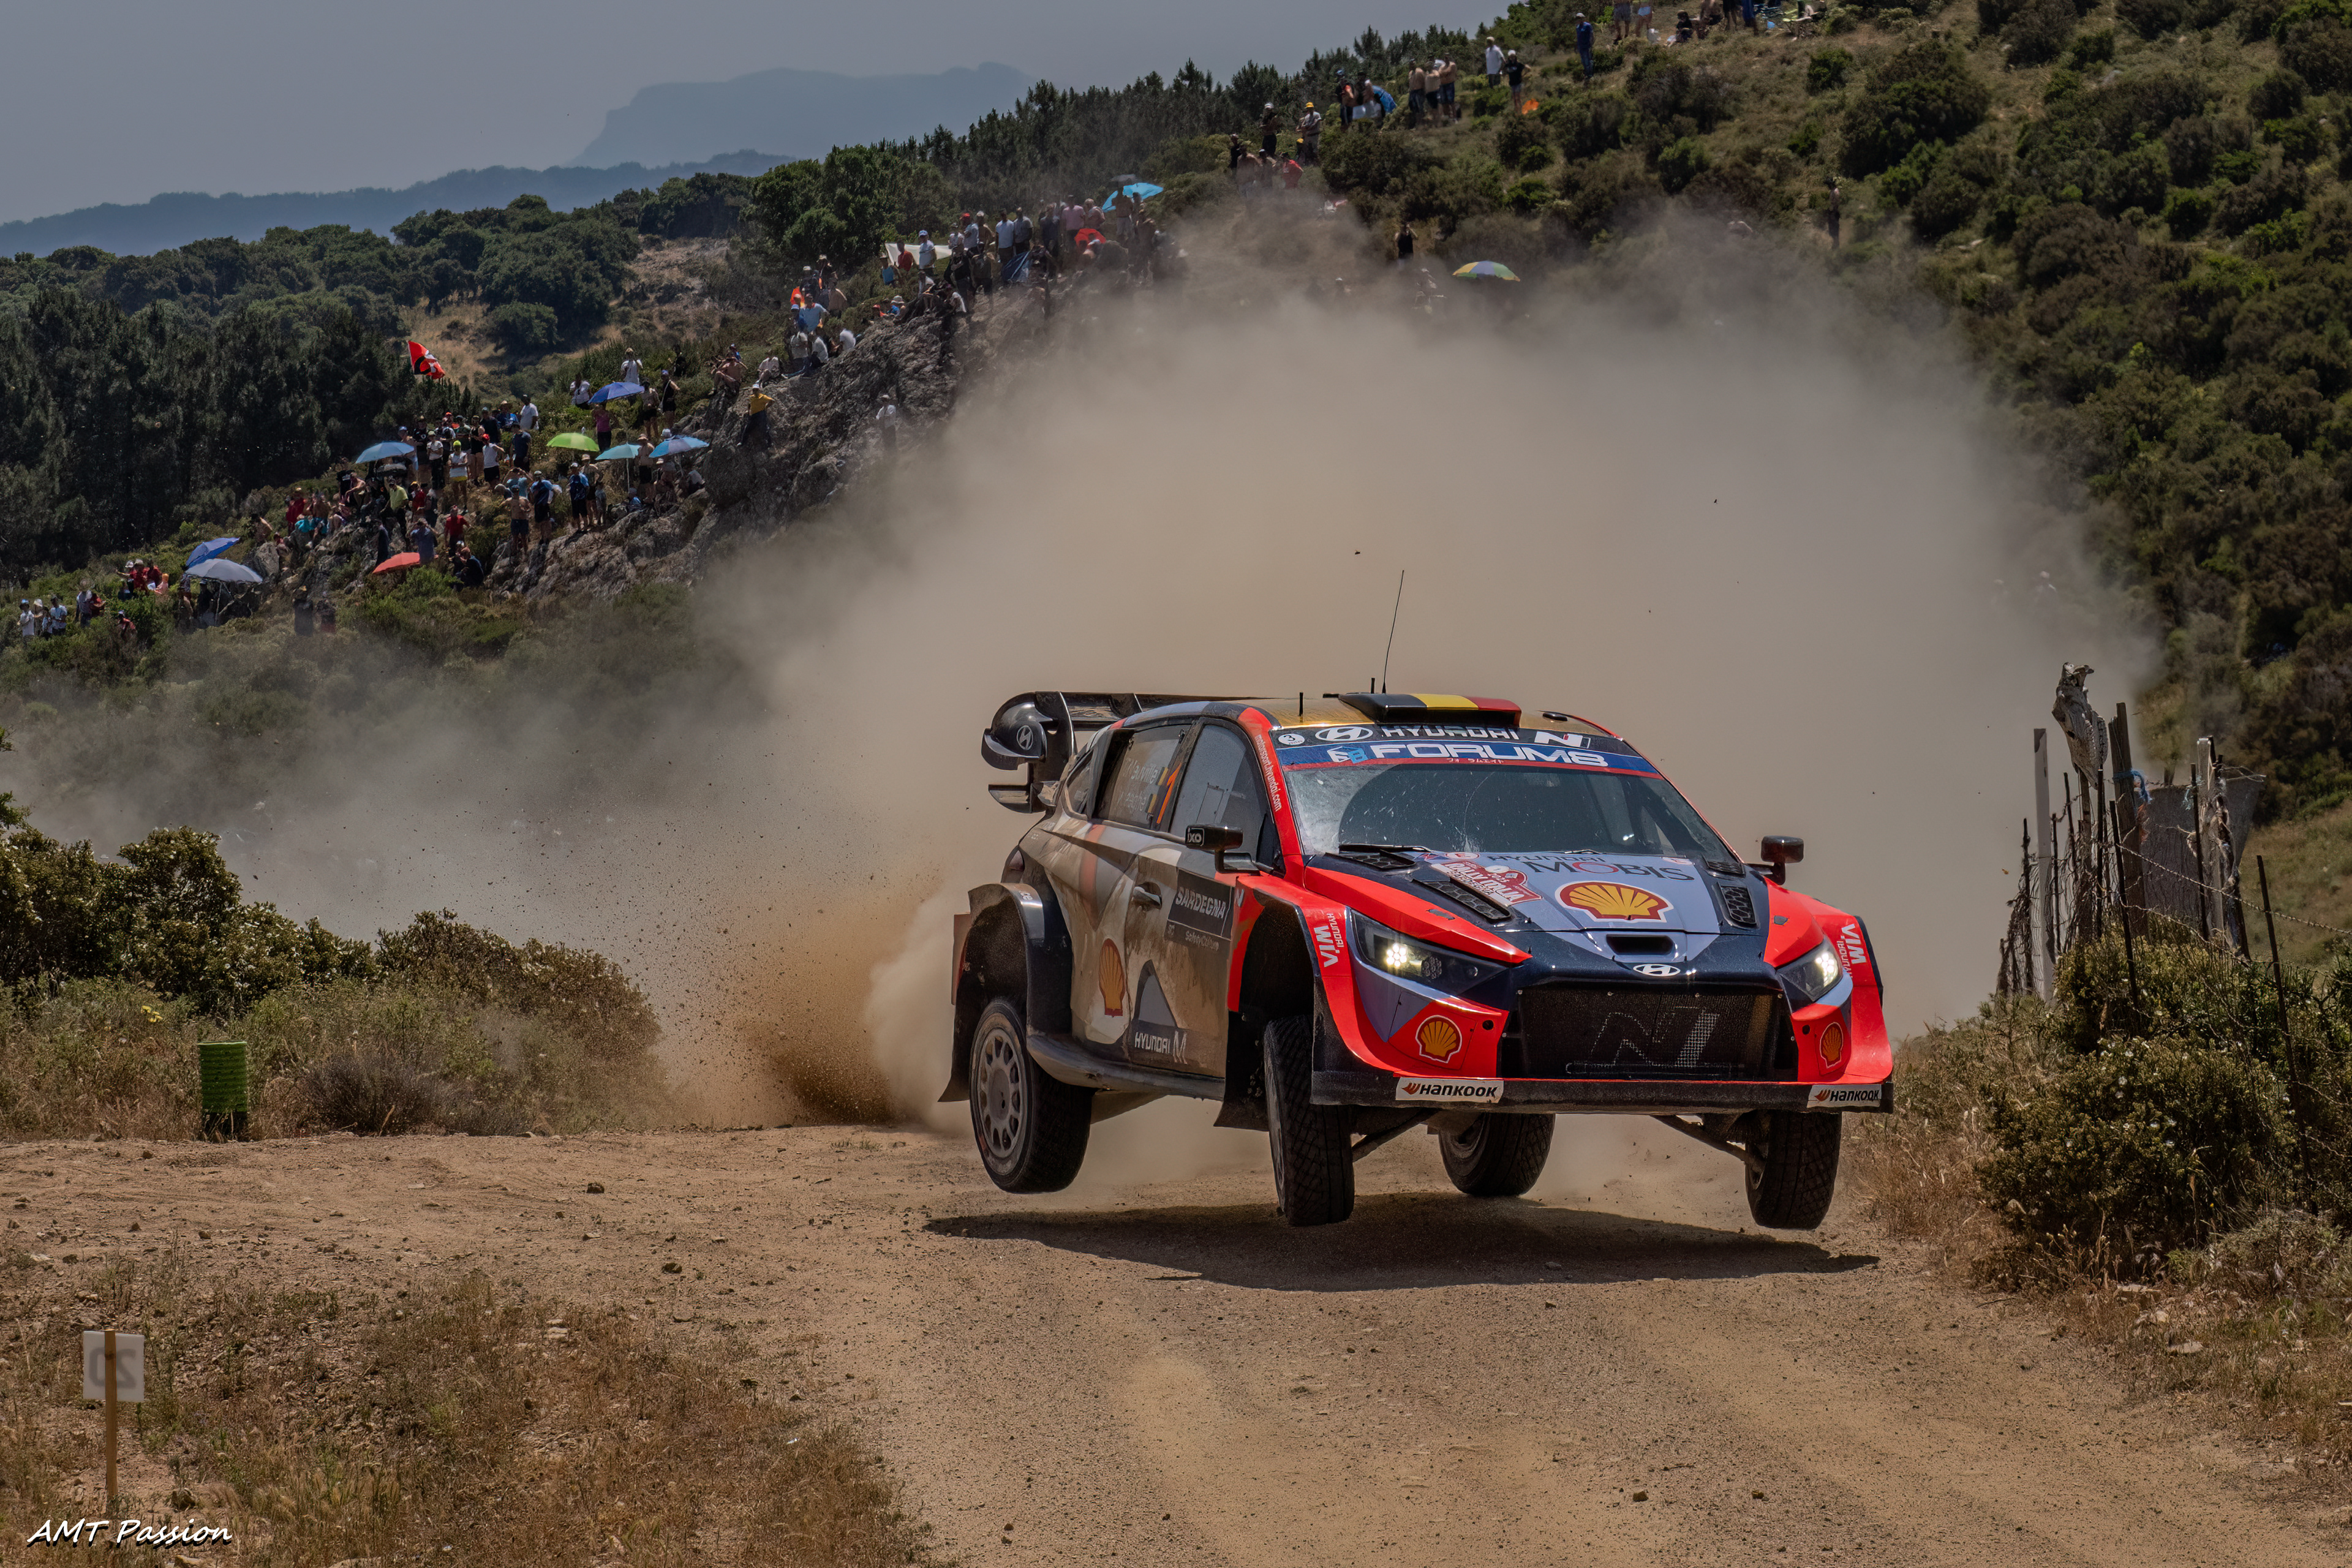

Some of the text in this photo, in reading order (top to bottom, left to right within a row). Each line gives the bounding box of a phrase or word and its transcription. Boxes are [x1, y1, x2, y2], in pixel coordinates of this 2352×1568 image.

[1382, 725, 1520, 740] HYUNDAI
[1370, 743, 1608, 767] FORUM8
[1255, 734, 1281, 812] motorsport.hyundai.com
[1523, 861, 1695, 881] MOBIS
[1175, 886, 1226, 919] SARDEGNA
[1326, 913, 1344, 948] HYUNDAI
[1134, 1031, 1170, 1054] HYUNDAI
